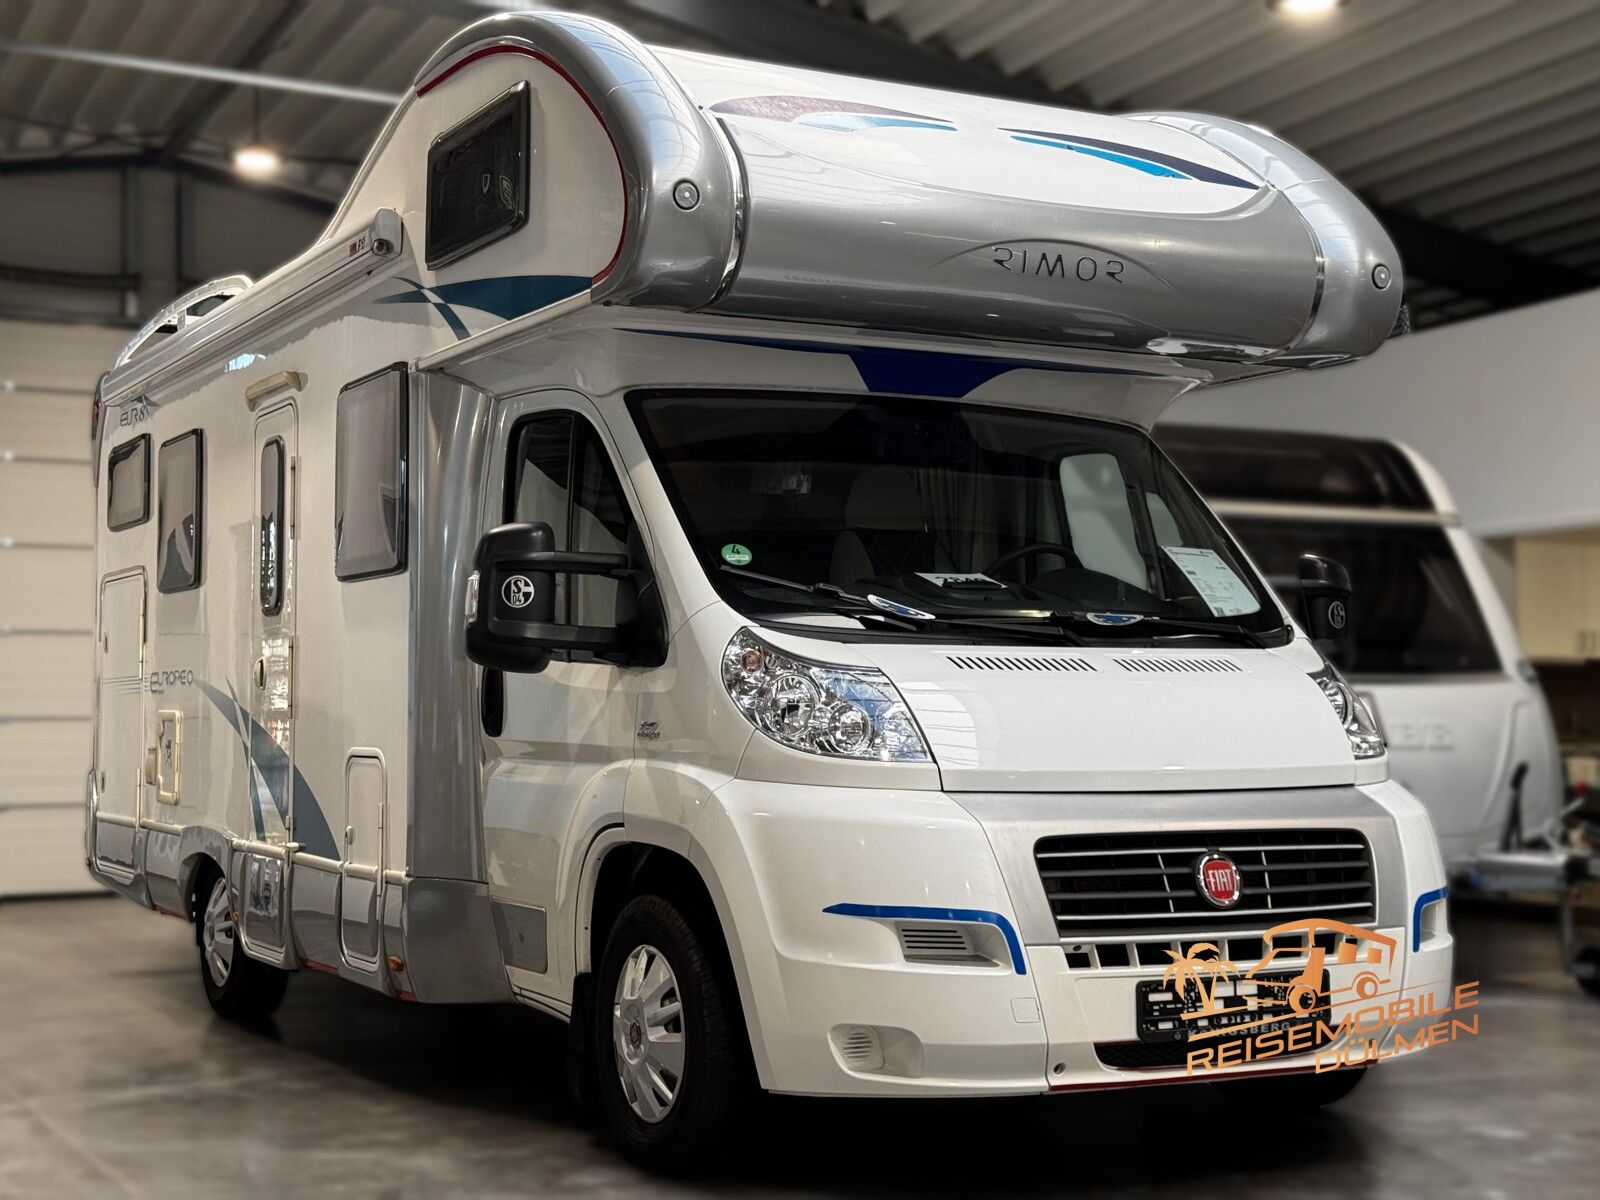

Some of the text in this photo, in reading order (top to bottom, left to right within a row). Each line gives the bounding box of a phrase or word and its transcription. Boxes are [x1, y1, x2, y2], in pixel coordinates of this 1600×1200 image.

[993, 247, 1125, 283] RIMOR
[731, 544, 741, 555] 4
[1208, 869, 1233, 892] FIAT
